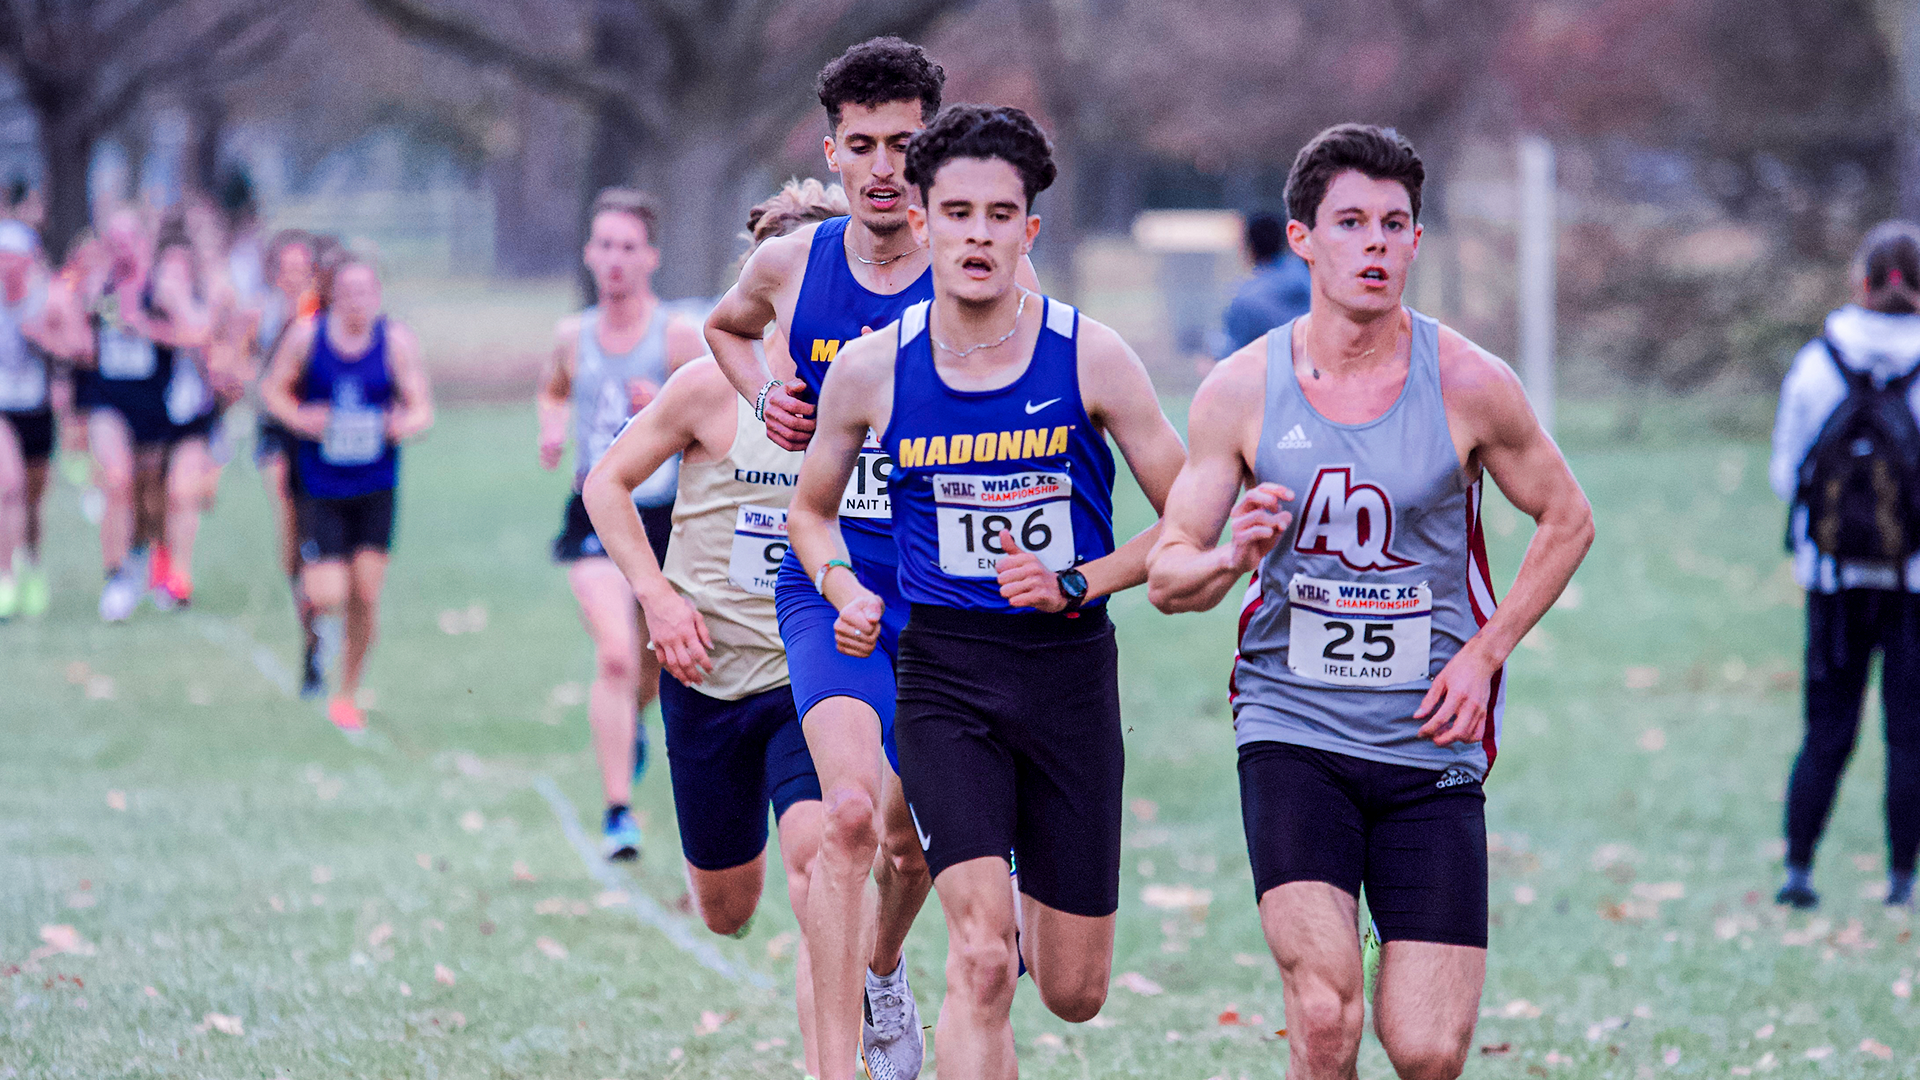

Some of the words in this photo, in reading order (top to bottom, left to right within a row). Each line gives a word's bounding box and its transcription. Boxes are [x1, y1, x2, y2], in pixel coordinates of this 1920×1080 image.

[899, 425, 1069, 468] MADONNA
[1277, 440, 1312, 449] adidas
[941, 482, 976, 498] WHAC
[982, 476, 1031, 492] WHAC
[1036, 475, 1058, 485] XC
[981, 484, 1060, 502] CHAMPIONSHIP
[846, 499, 879, 510] NAIT
[745, 512, 775, 528] WHAC
[1294, 466, 1422, 572] AQ
[958, 507, 1052, 555] 186
[1296, 584, 1331, 603] WHAC
[1338, 586, 1391, 600] WHAC
[1396, 586, 1419, 599] XC
[1335, 599, 1420, 610] CHAMPIONSHIP
[1322, 620, 1396, 663] 25
[1324, 663, 1393, 678] IRELAND
